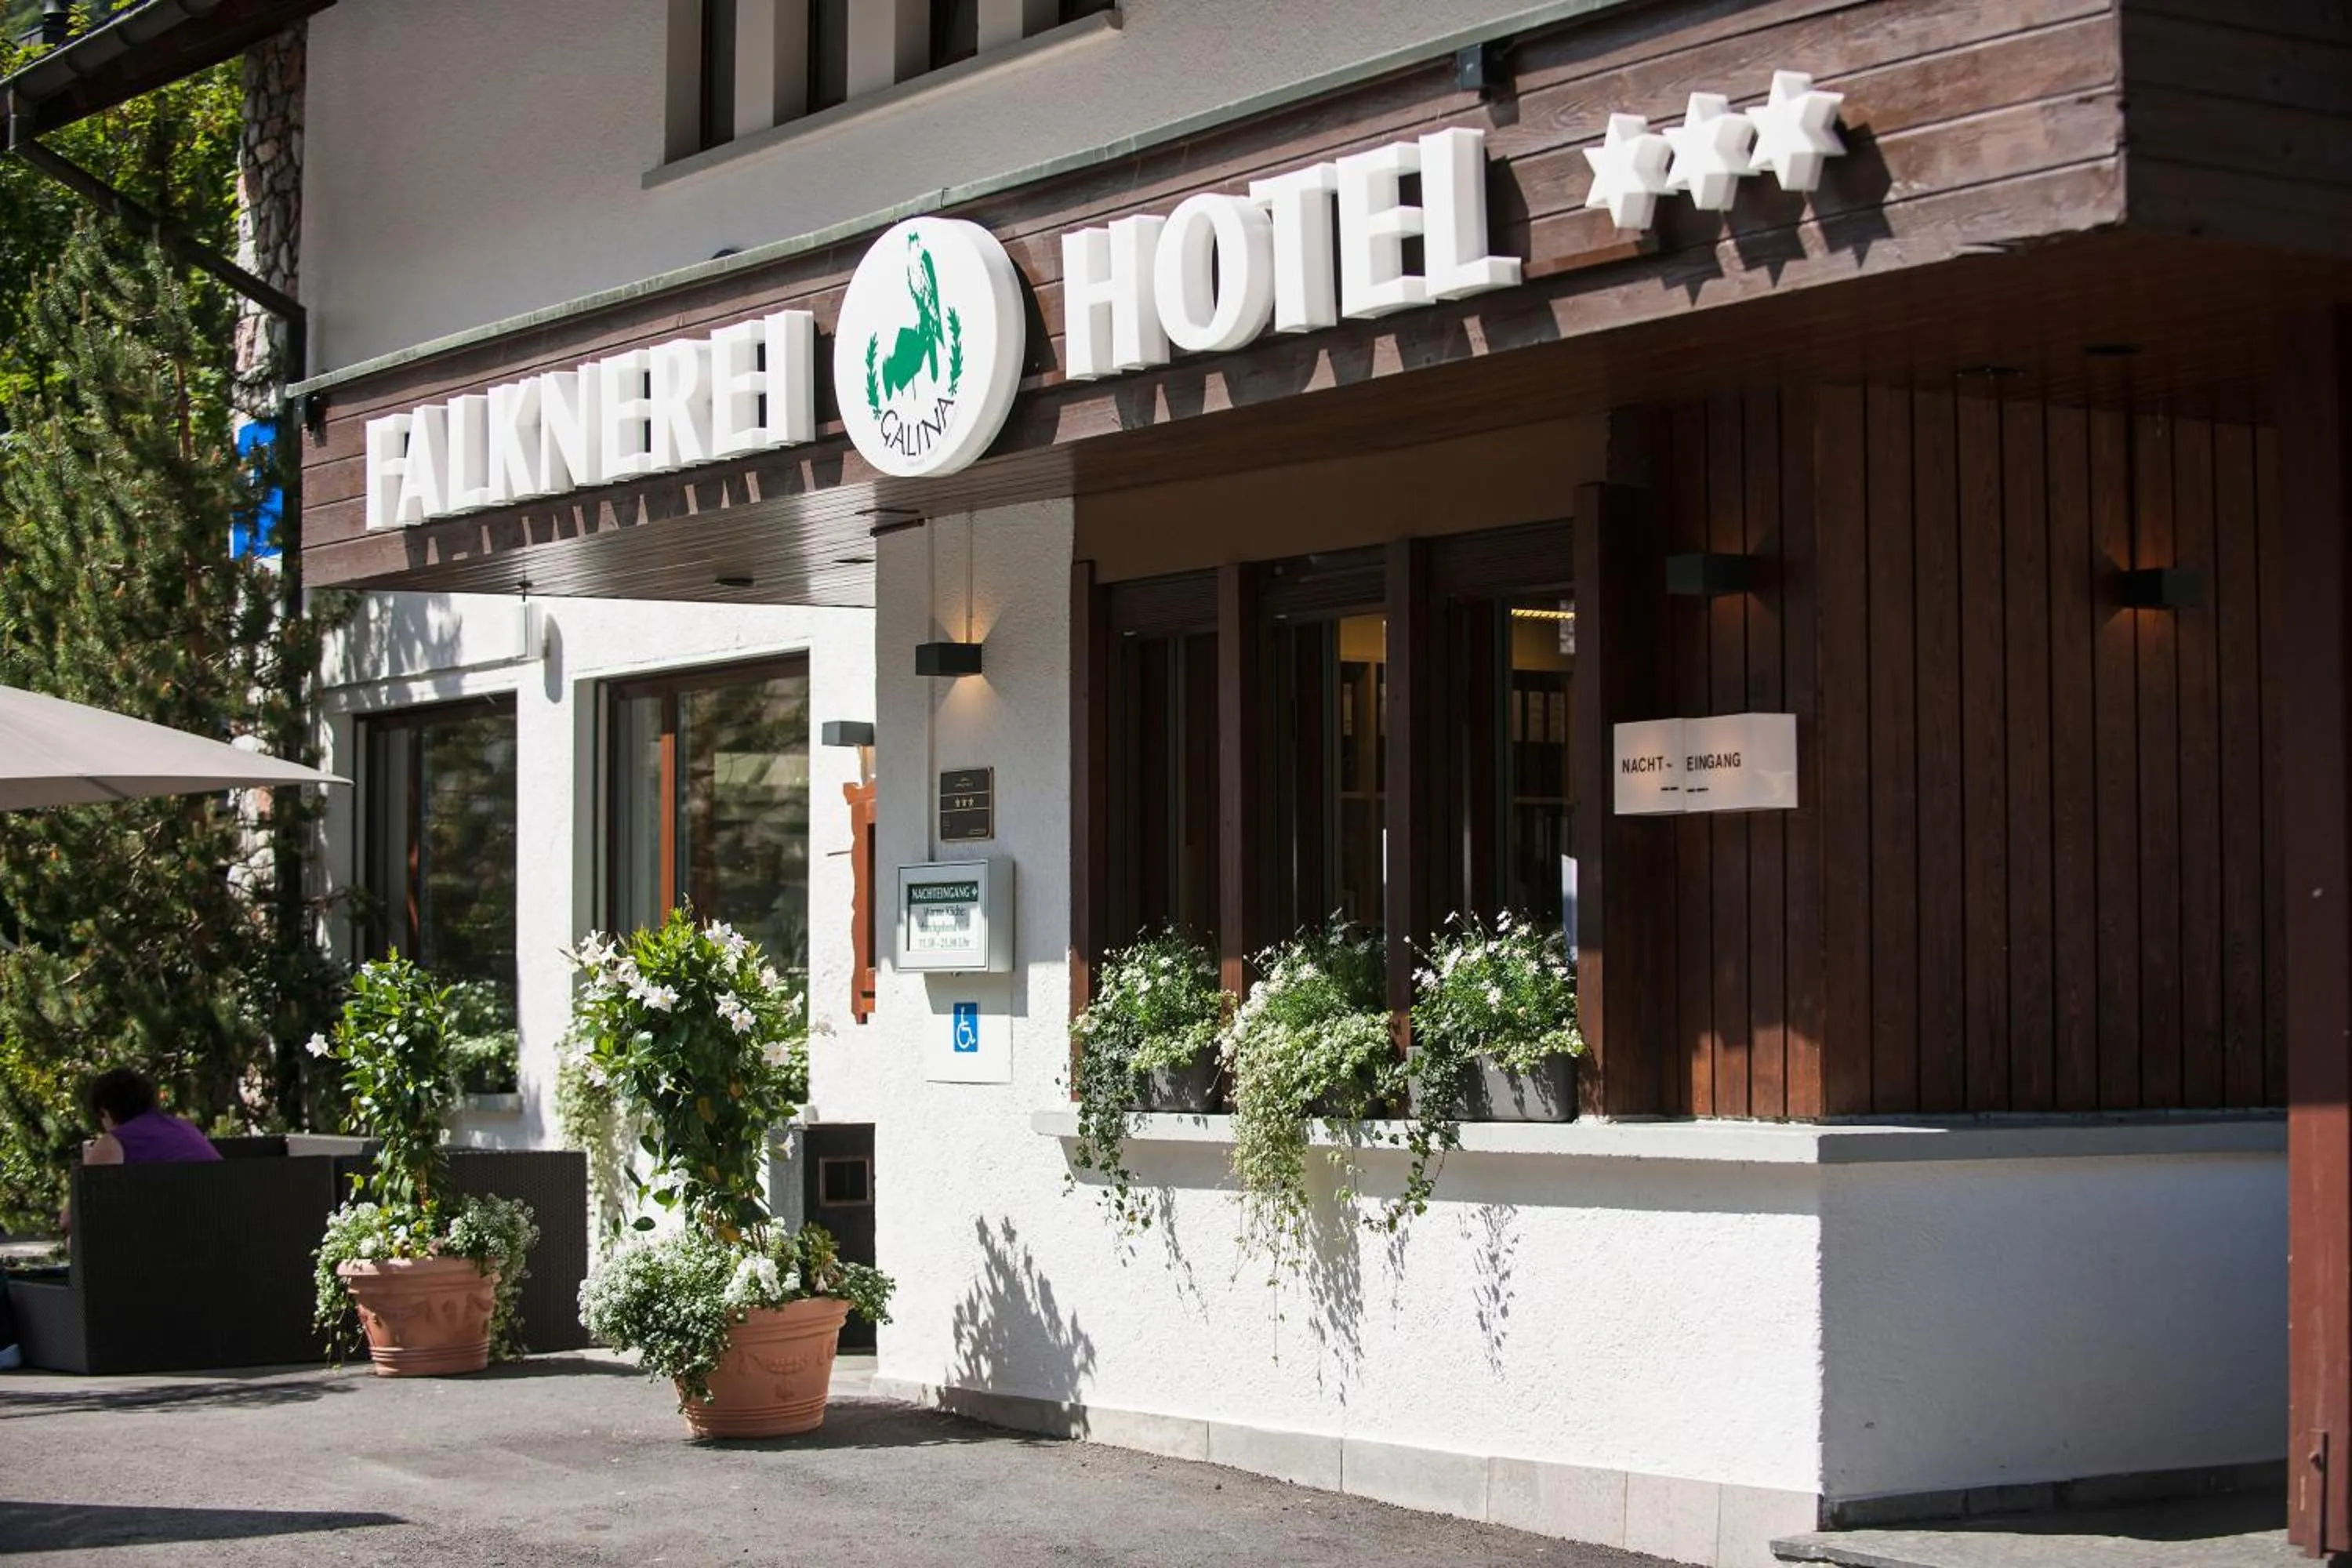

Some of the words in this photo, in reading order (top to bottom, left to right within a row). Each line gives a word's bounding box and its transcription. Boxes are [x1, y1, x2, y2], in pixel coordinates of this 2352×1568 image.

[366, 310, 815, 532] FALKNEREI
[1062, 126, 1523, 381] HOTEL
[880, 397, 954, 456] GALINA
[1686, 752, 1742, 771] EINGANG
